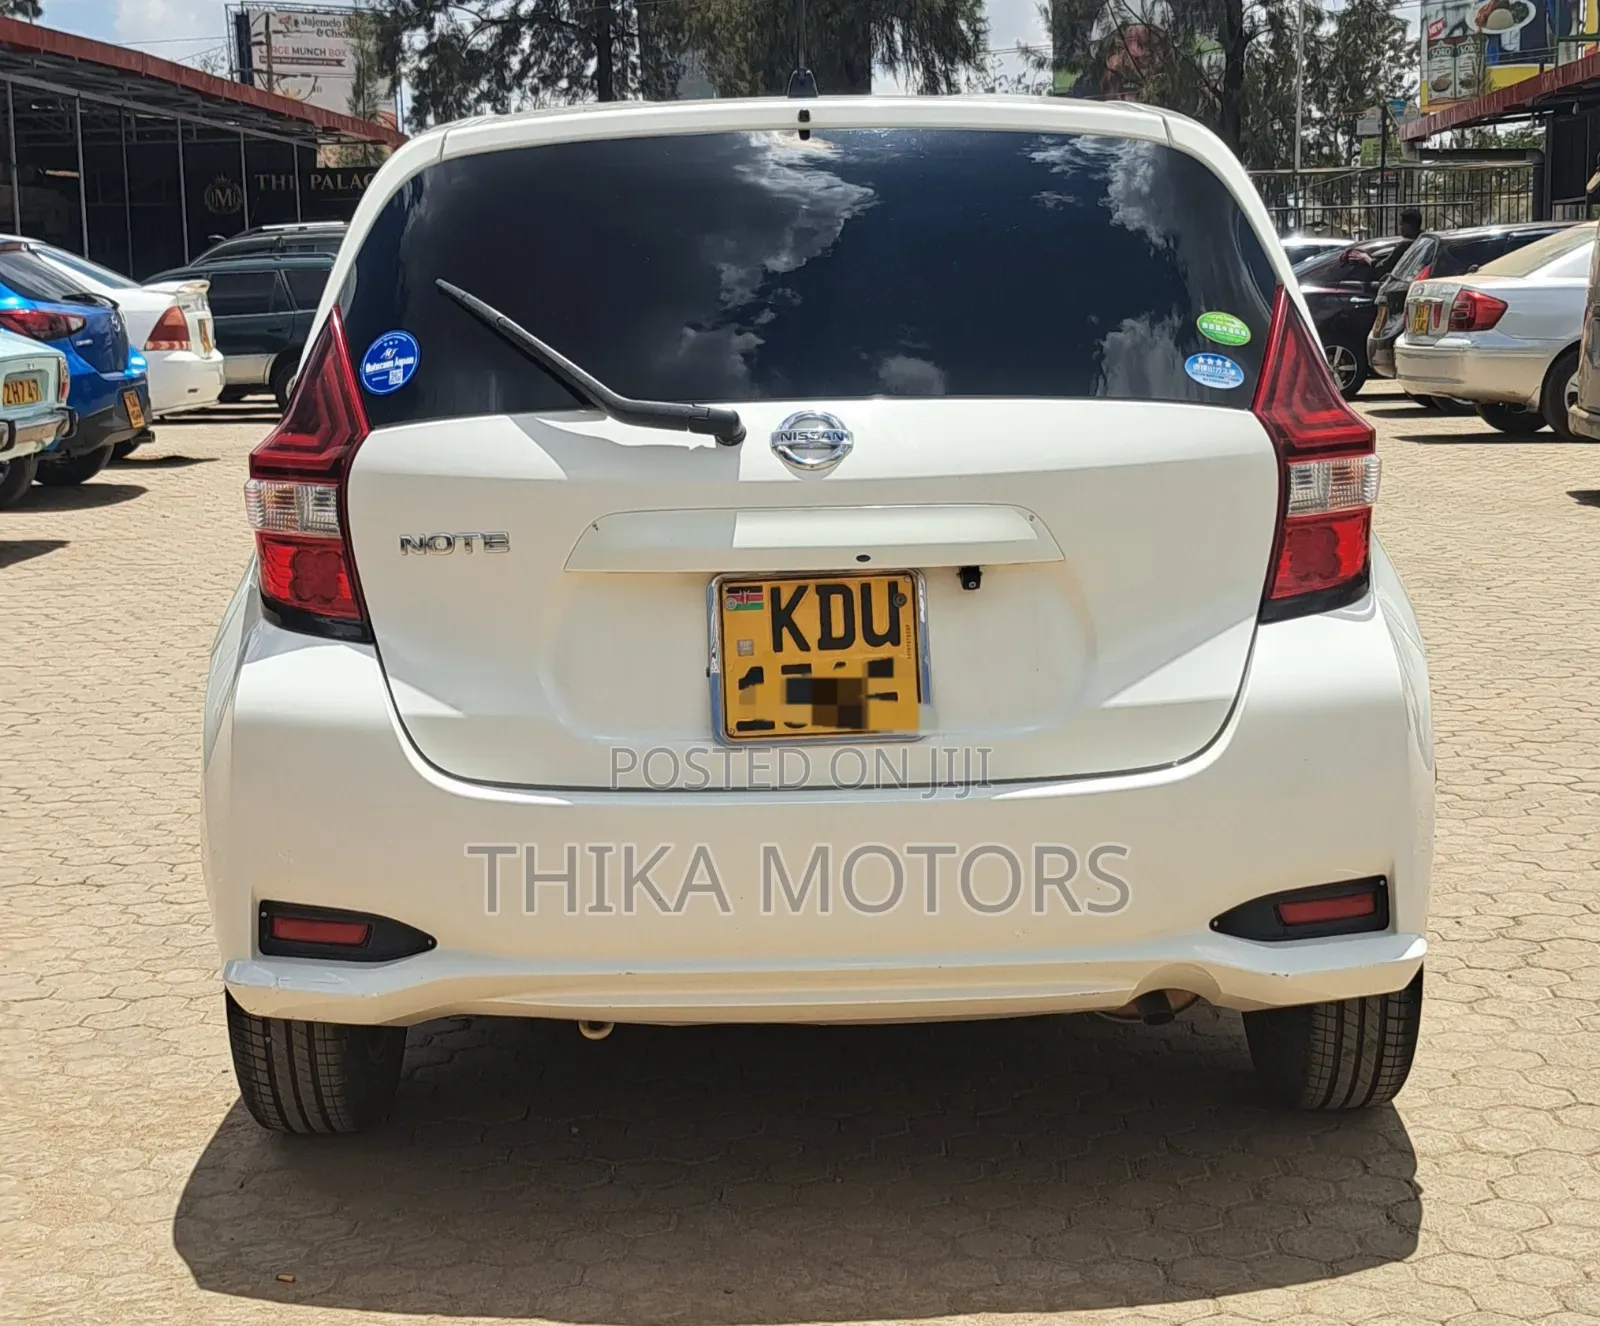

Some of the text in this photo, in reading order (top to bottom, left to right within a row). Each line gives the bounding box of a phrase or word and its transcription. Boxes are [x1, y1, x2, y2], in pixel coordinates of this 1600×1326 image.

[291, 47, 327, 57] MUNCH
[328, 48, 348, 58] BOX
[780, 431, 844, 442] NISSAN
[399, 531, 510, 556] NOTE
[769, 580, 901, 653] KDU
